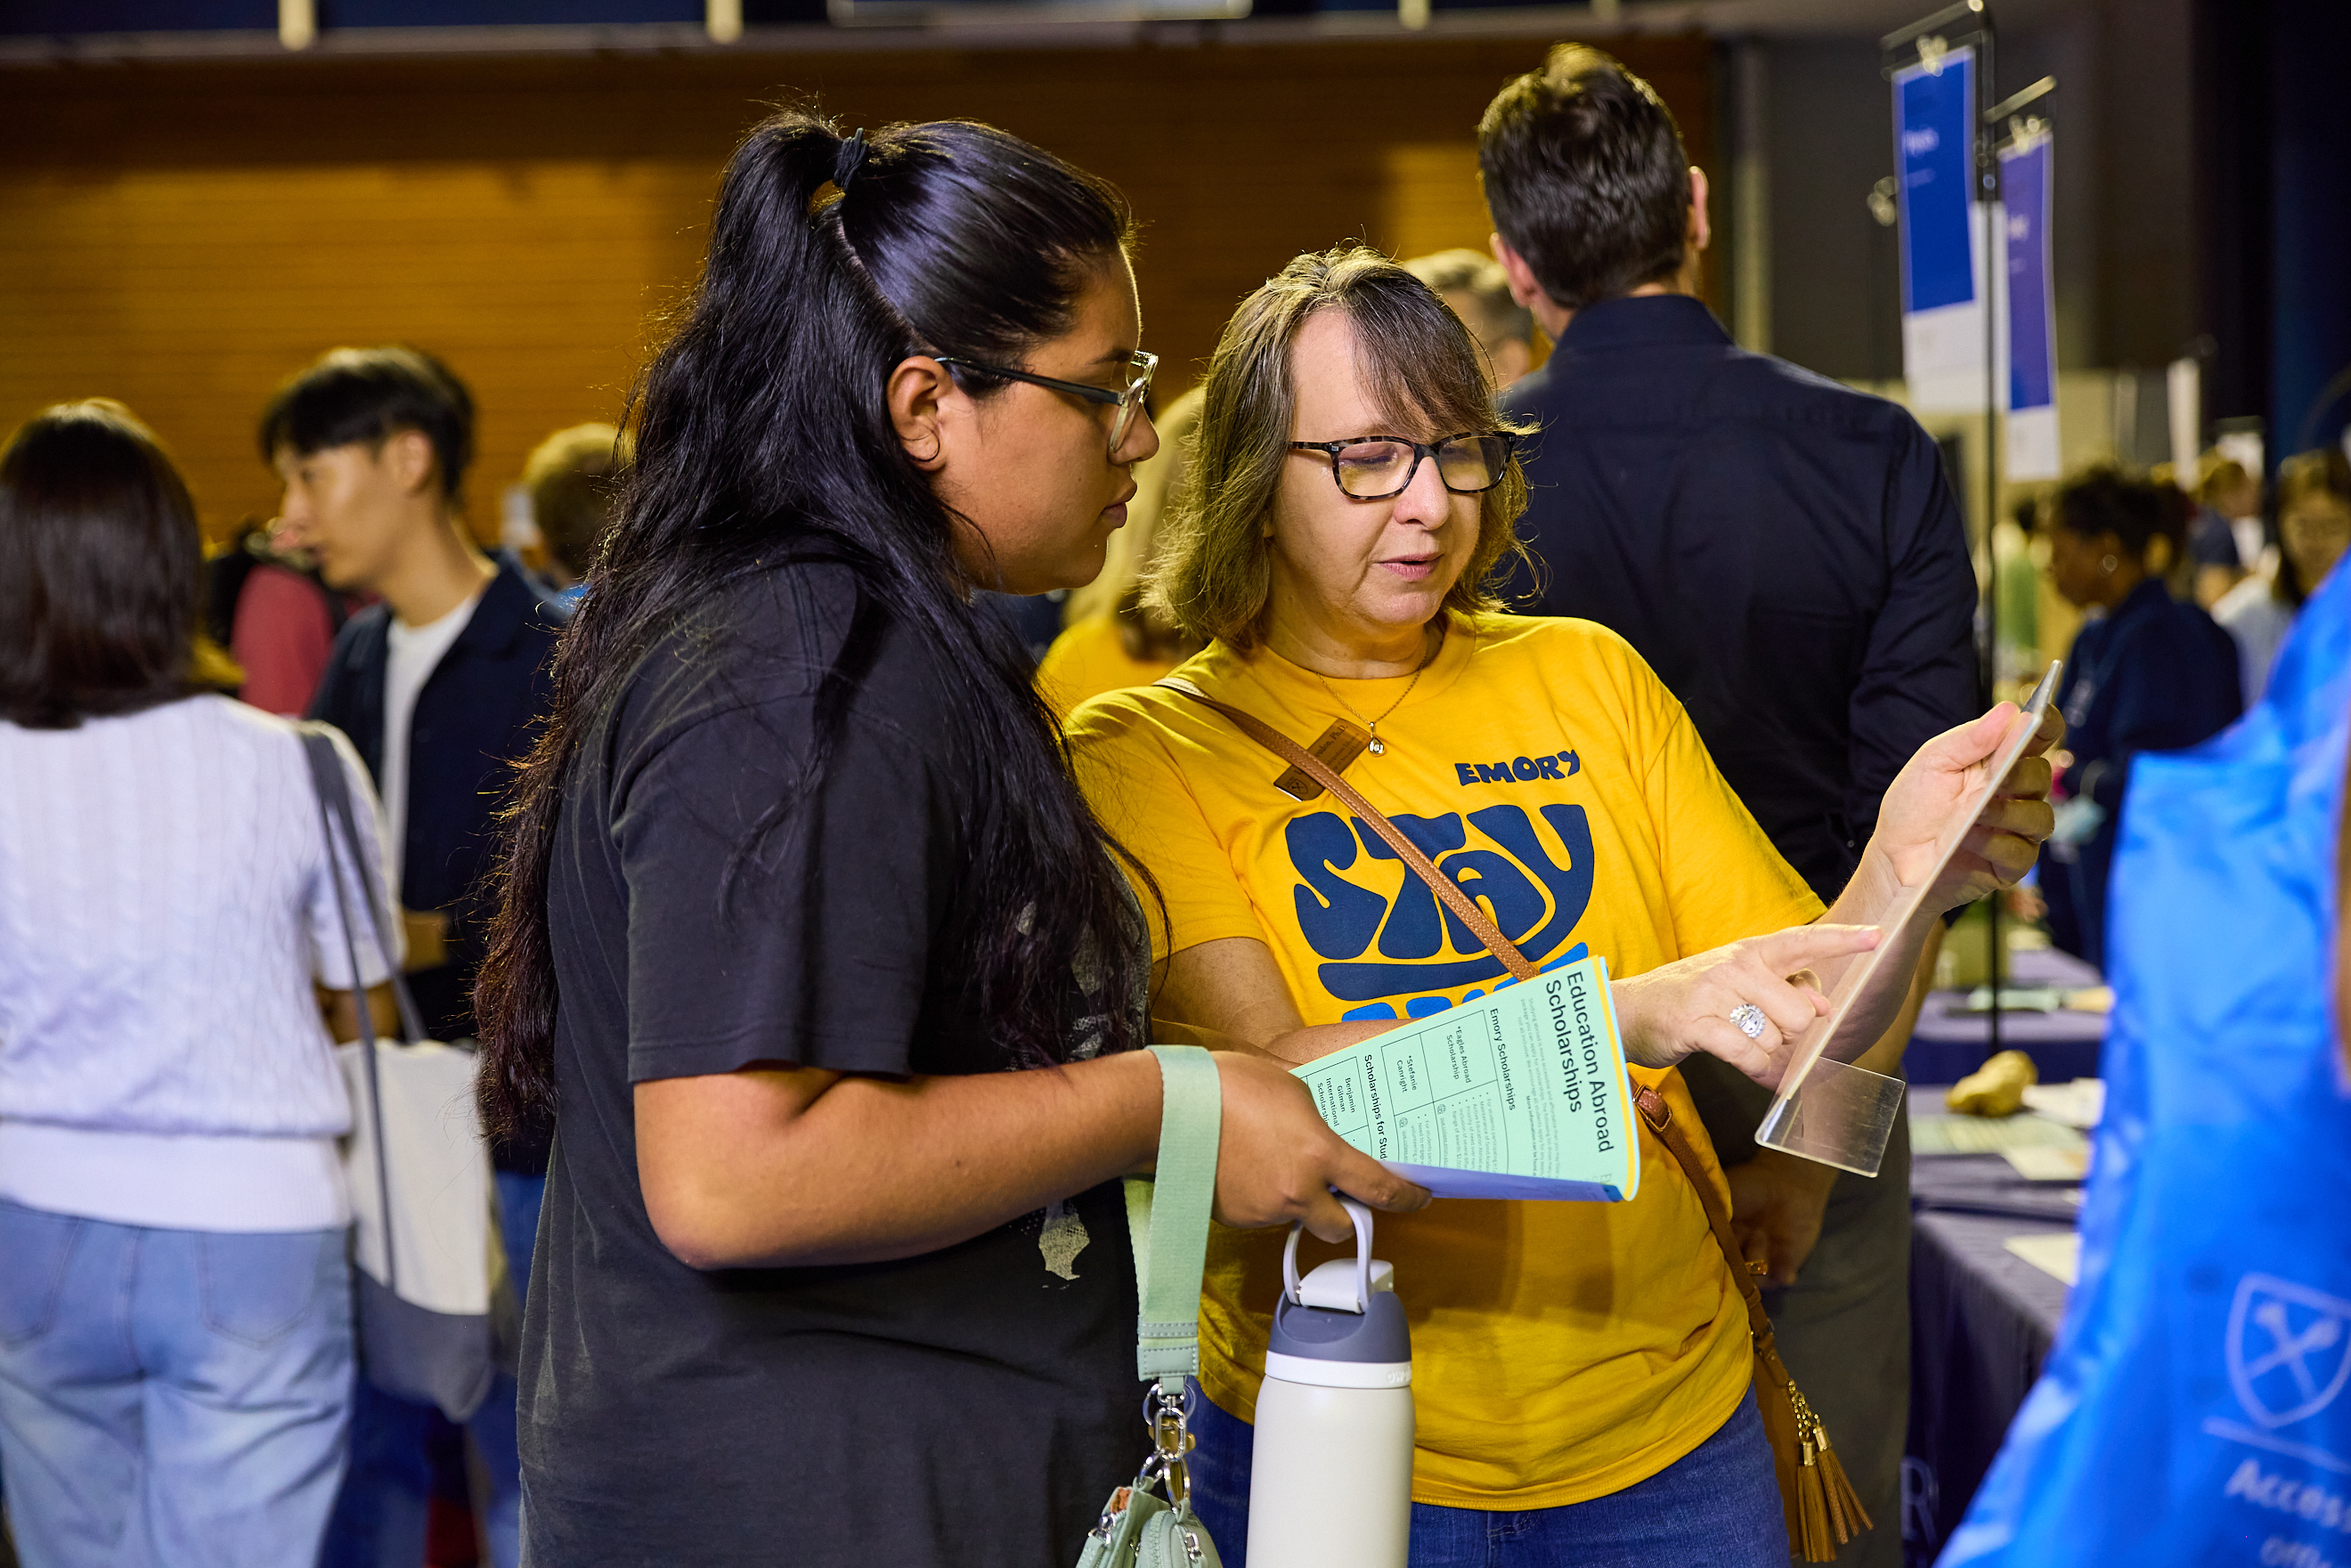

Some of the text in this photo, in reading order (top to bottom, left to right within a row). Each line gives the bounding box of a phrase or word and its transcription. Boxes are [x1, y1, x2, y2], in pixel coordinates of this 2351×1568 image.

[1454, 750, 1581, 786] EMORY
[1520, 998, 1529, 1020] package
[1446, 1035, 1460, 1079] Scholarship
[1490, 1008, 1515, 1110] Emory Scholarships
[1546, 979, 1582, 1112] Scholarships
[1566, 971, 1598, 1074] Education
[1589, 1080, 1614, 1152] Abroad
[1396, 1060, 1407, 1093] Canright
[1460, 1055, 1471, 1083] Abroad
[1542, 1062, 1550, 1089] accessible
[1326, 1077, 1339, 1126] International
[1337, 1085, 1346, 1112] Gilman
[1345, 1076, 1355, 1113] Benjamin
[1364, 1054, 1387, 1160] Scholarships for Stud
